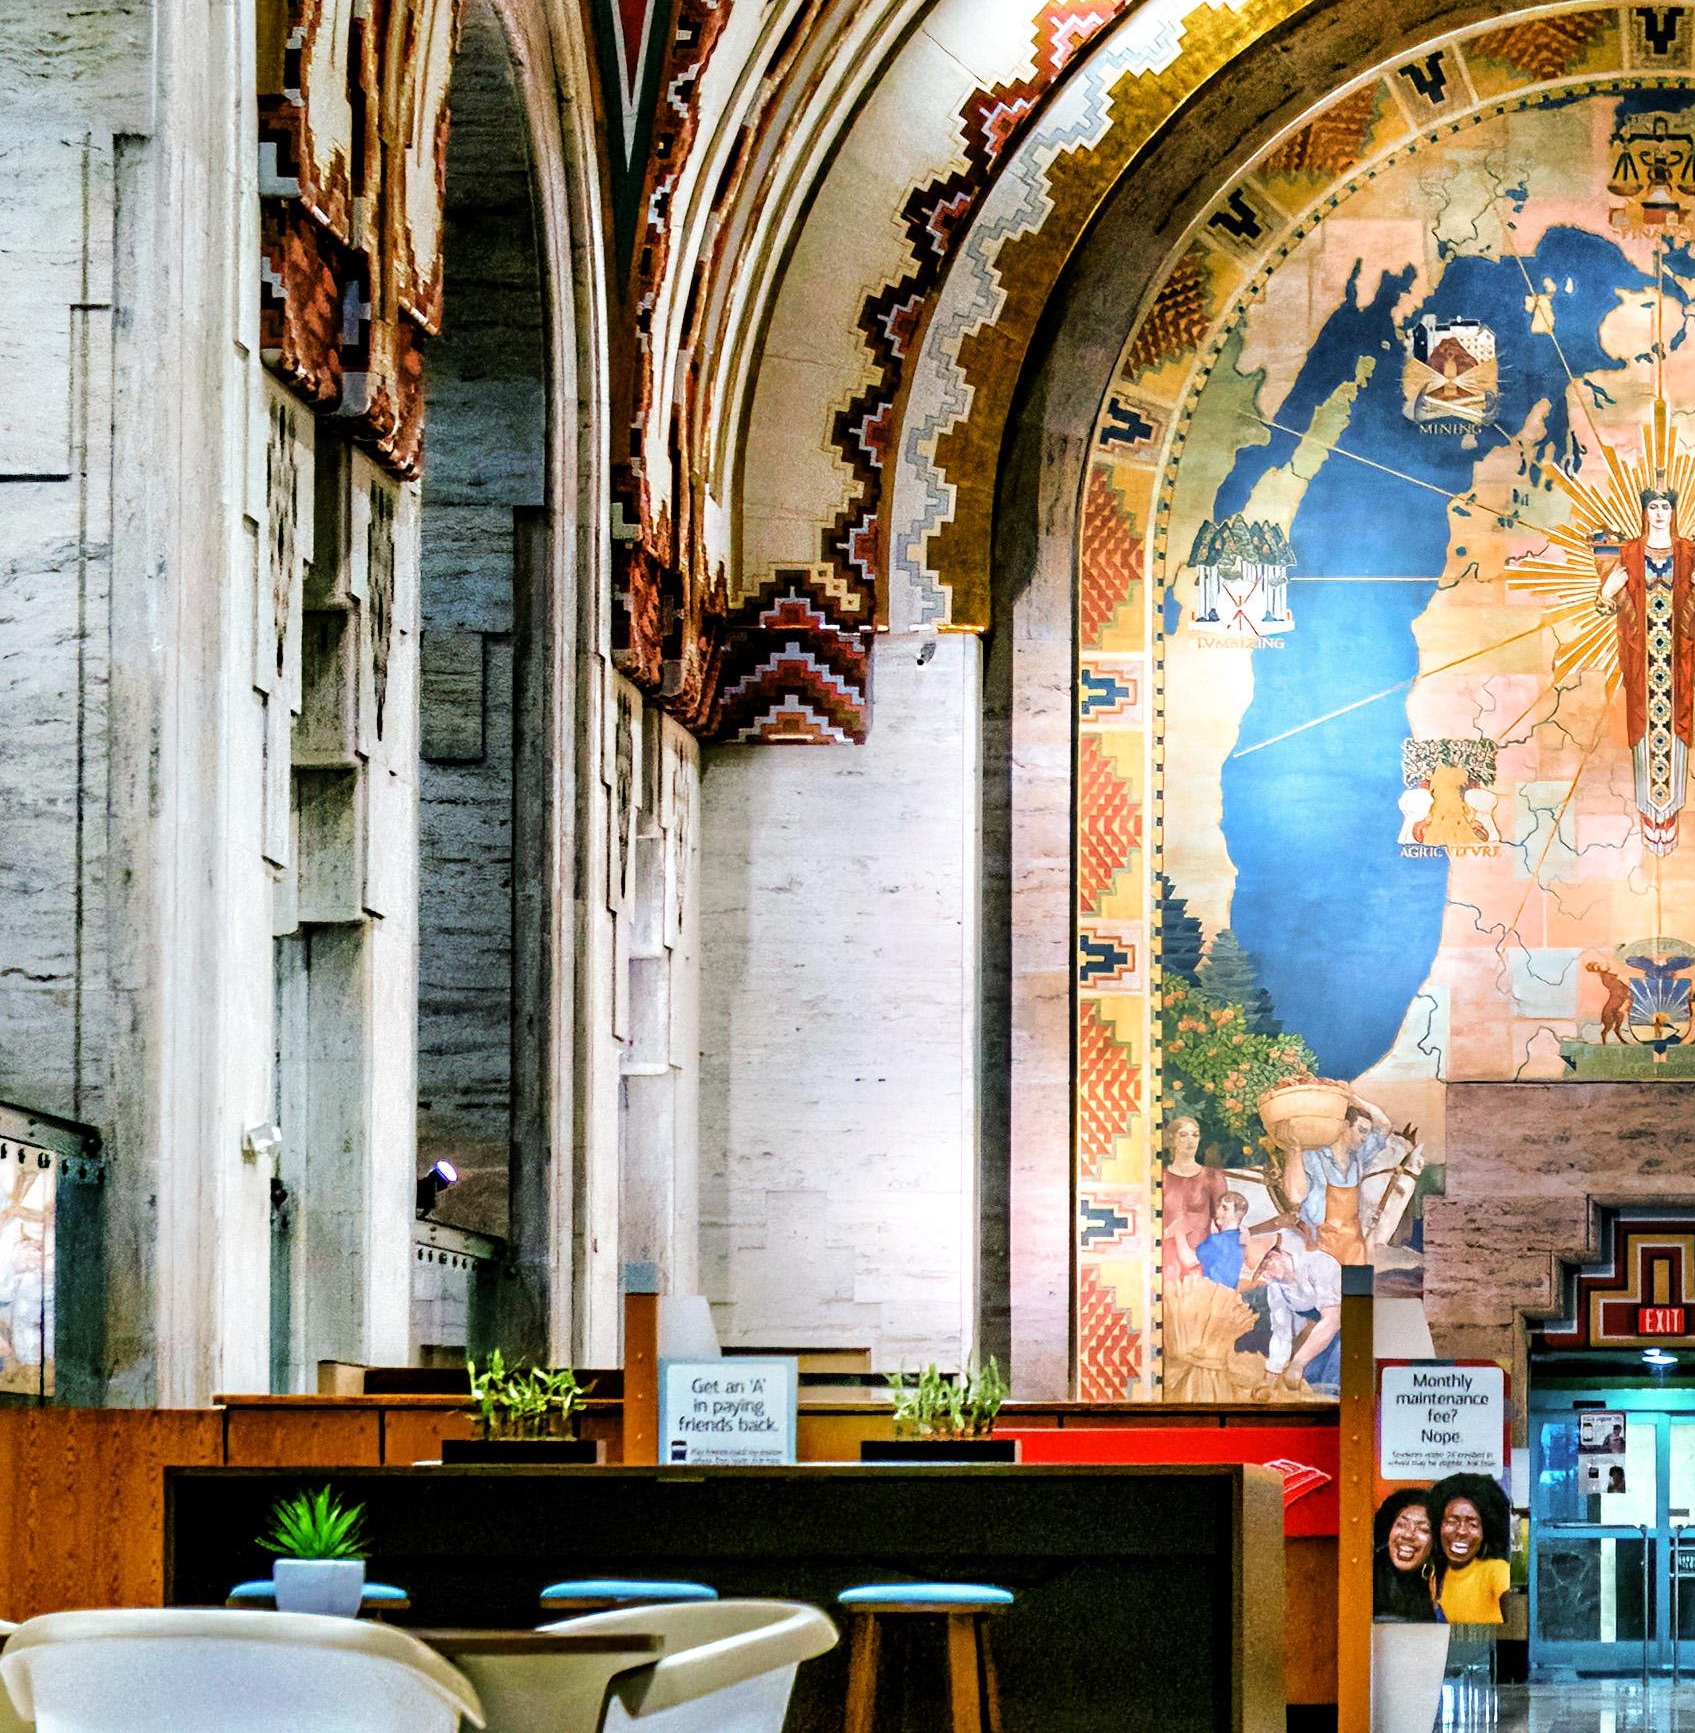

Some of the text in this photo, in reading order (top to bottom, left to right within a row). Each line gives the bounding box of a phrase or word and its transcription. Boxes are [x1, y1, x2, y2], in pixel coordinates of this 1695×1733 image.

[1418, 423, 1482, 435] MINING
[1645, 1308, 1679, 1333] EXIT
[691, 1377, 766, 1394] Get an 'A'
[1413, 1373, 1473, 1392] Monthly
[1396, 1392, 1489, 1405] maintenance
[693, 1399, 764, 1417] in paying
[1428, 1408, 1458, 1423] fee?
[679, 1416, 779, 1432] friends back.
